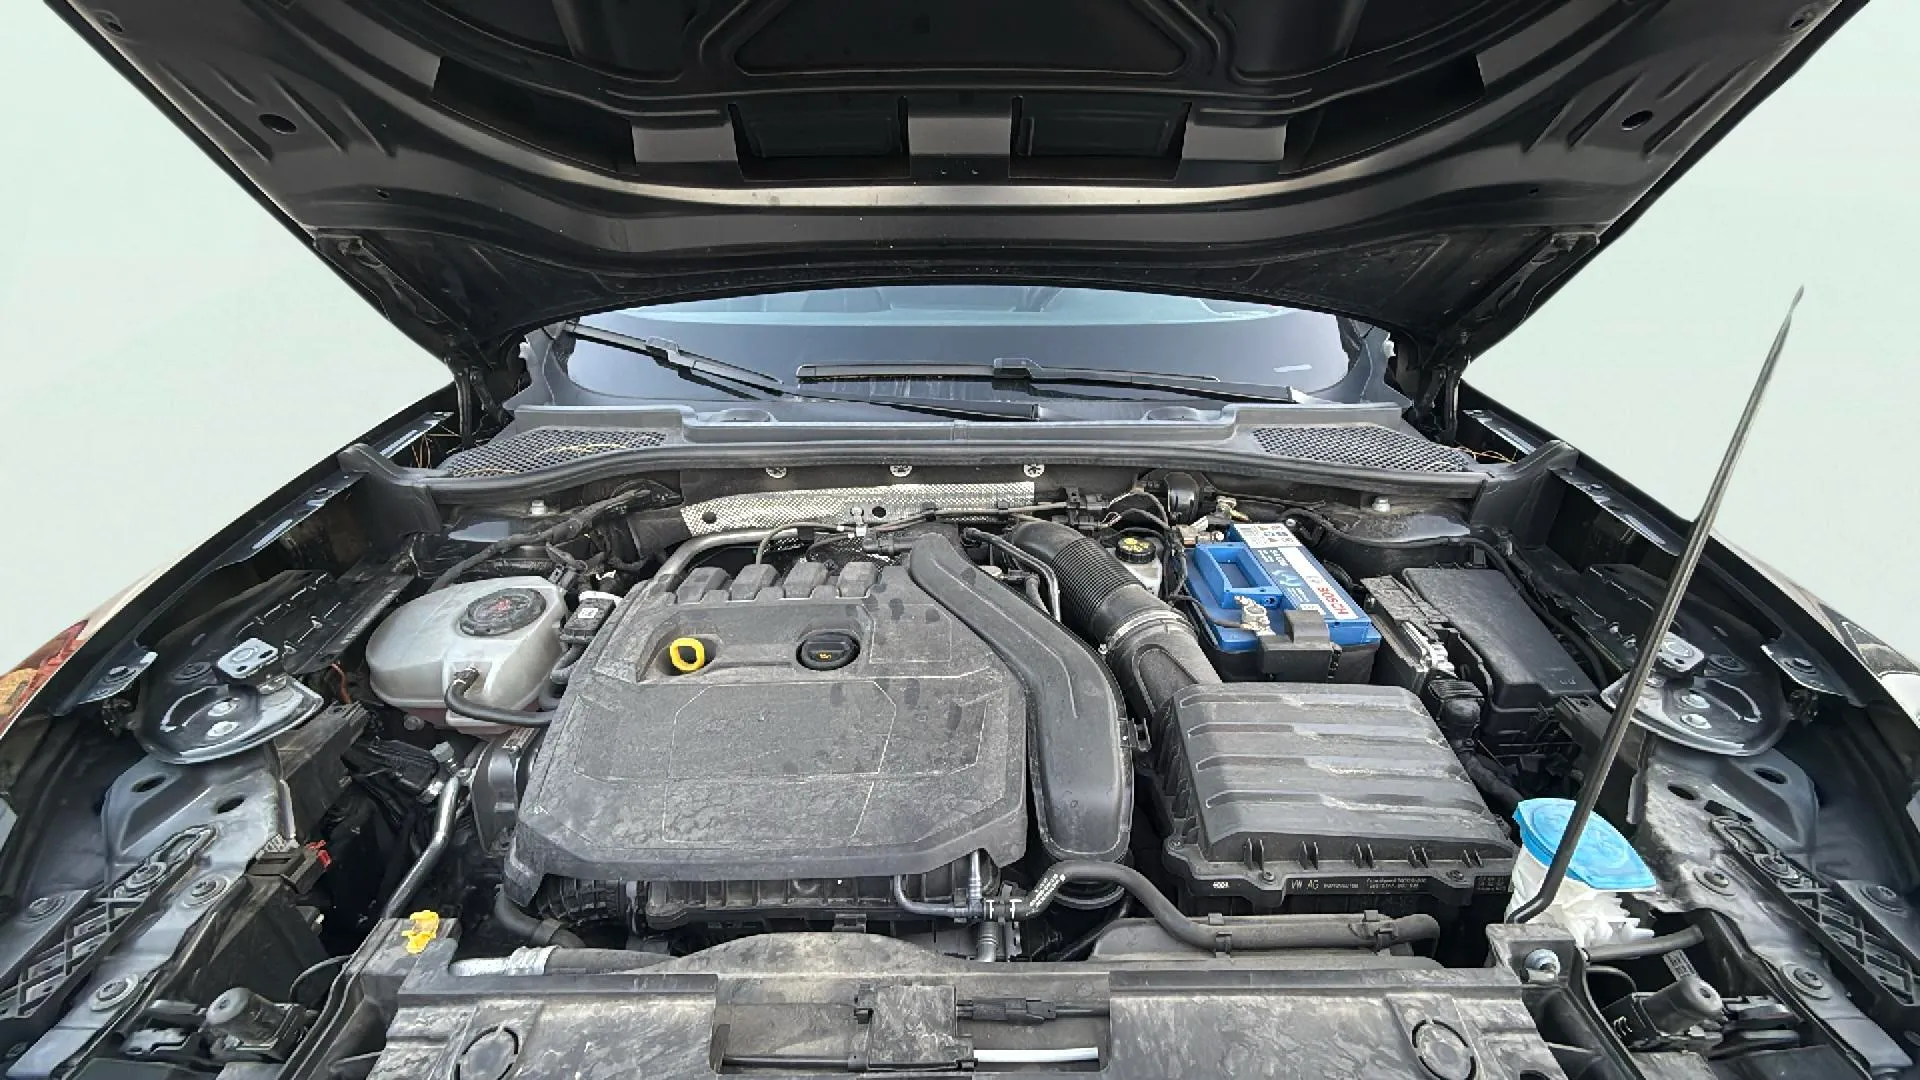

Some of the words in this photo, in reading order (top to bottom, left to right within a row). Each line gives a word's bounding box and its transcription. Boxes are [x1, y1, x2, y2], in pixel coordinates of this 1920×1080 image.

[1317, 587, 1348, 615] BOSCH
[1291, 879, 1303, 890] VW
[1307, 879, 1319, 890] AG
